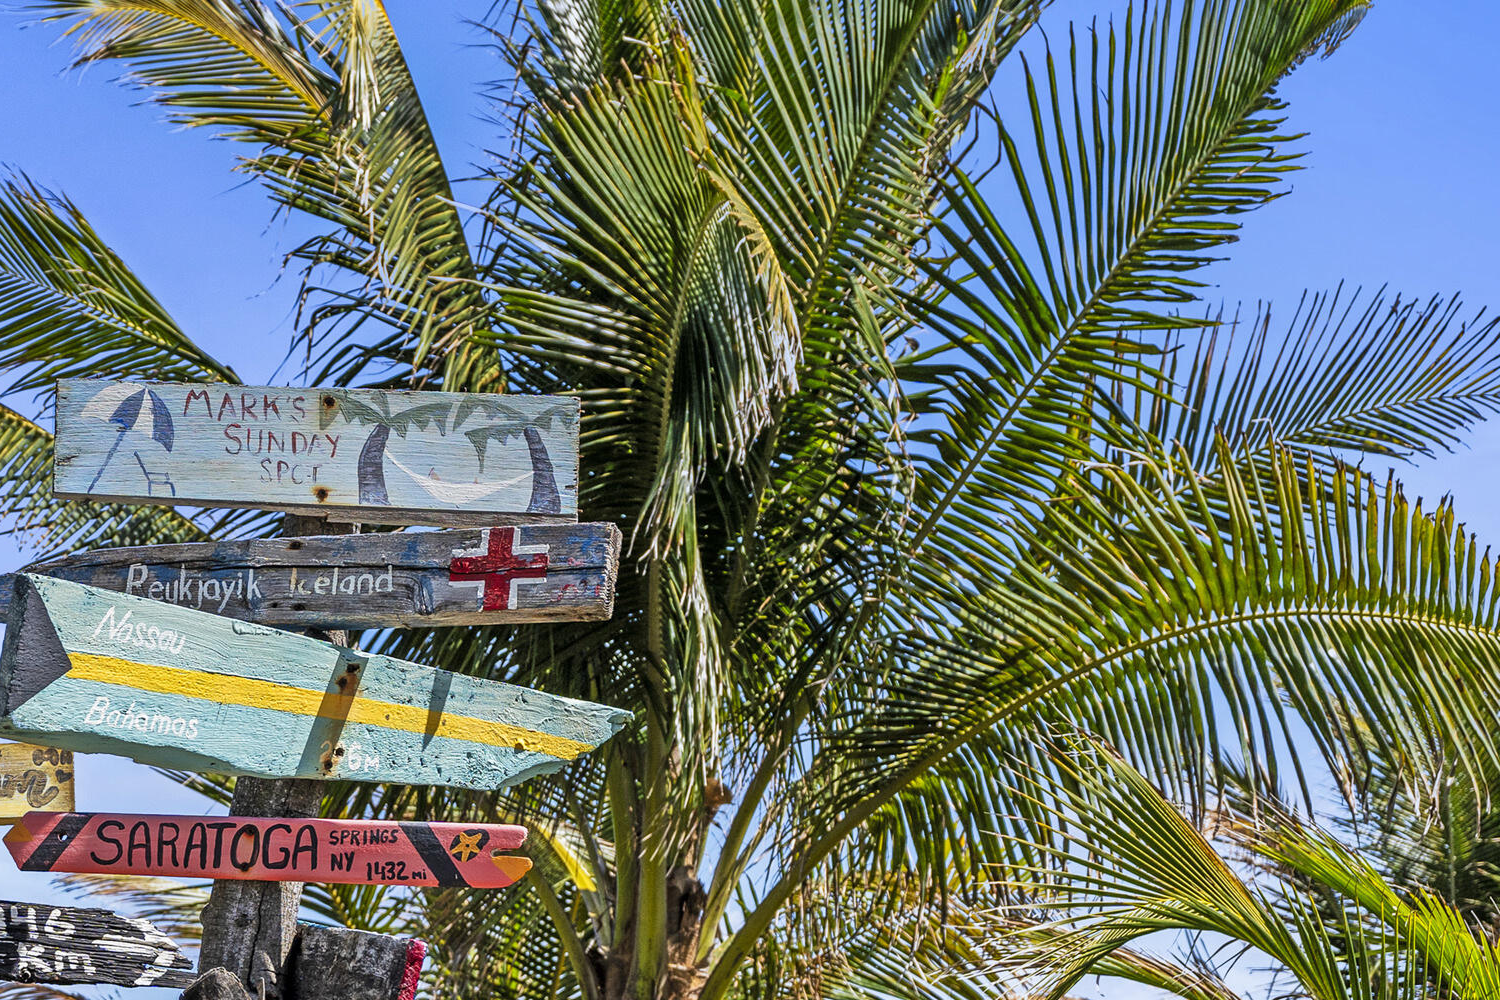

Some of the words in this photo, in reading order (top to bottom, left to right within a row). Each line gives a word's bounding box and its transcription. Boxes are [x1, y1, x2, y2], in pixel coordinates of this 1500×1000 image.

[184, 389, 306, 422] MARK'S
[224, 423, 341, 458] SUNDAY
[289, 565, 393, 598] Iceland
[92, 606, 186, 654] Nassau
[84, 696, 199, 739] Bahamas
[90, 820, 318, 872] SARATOGA
[329, 829, 399, 846] SPRINGS
[331, 851, 355, 872] NY
